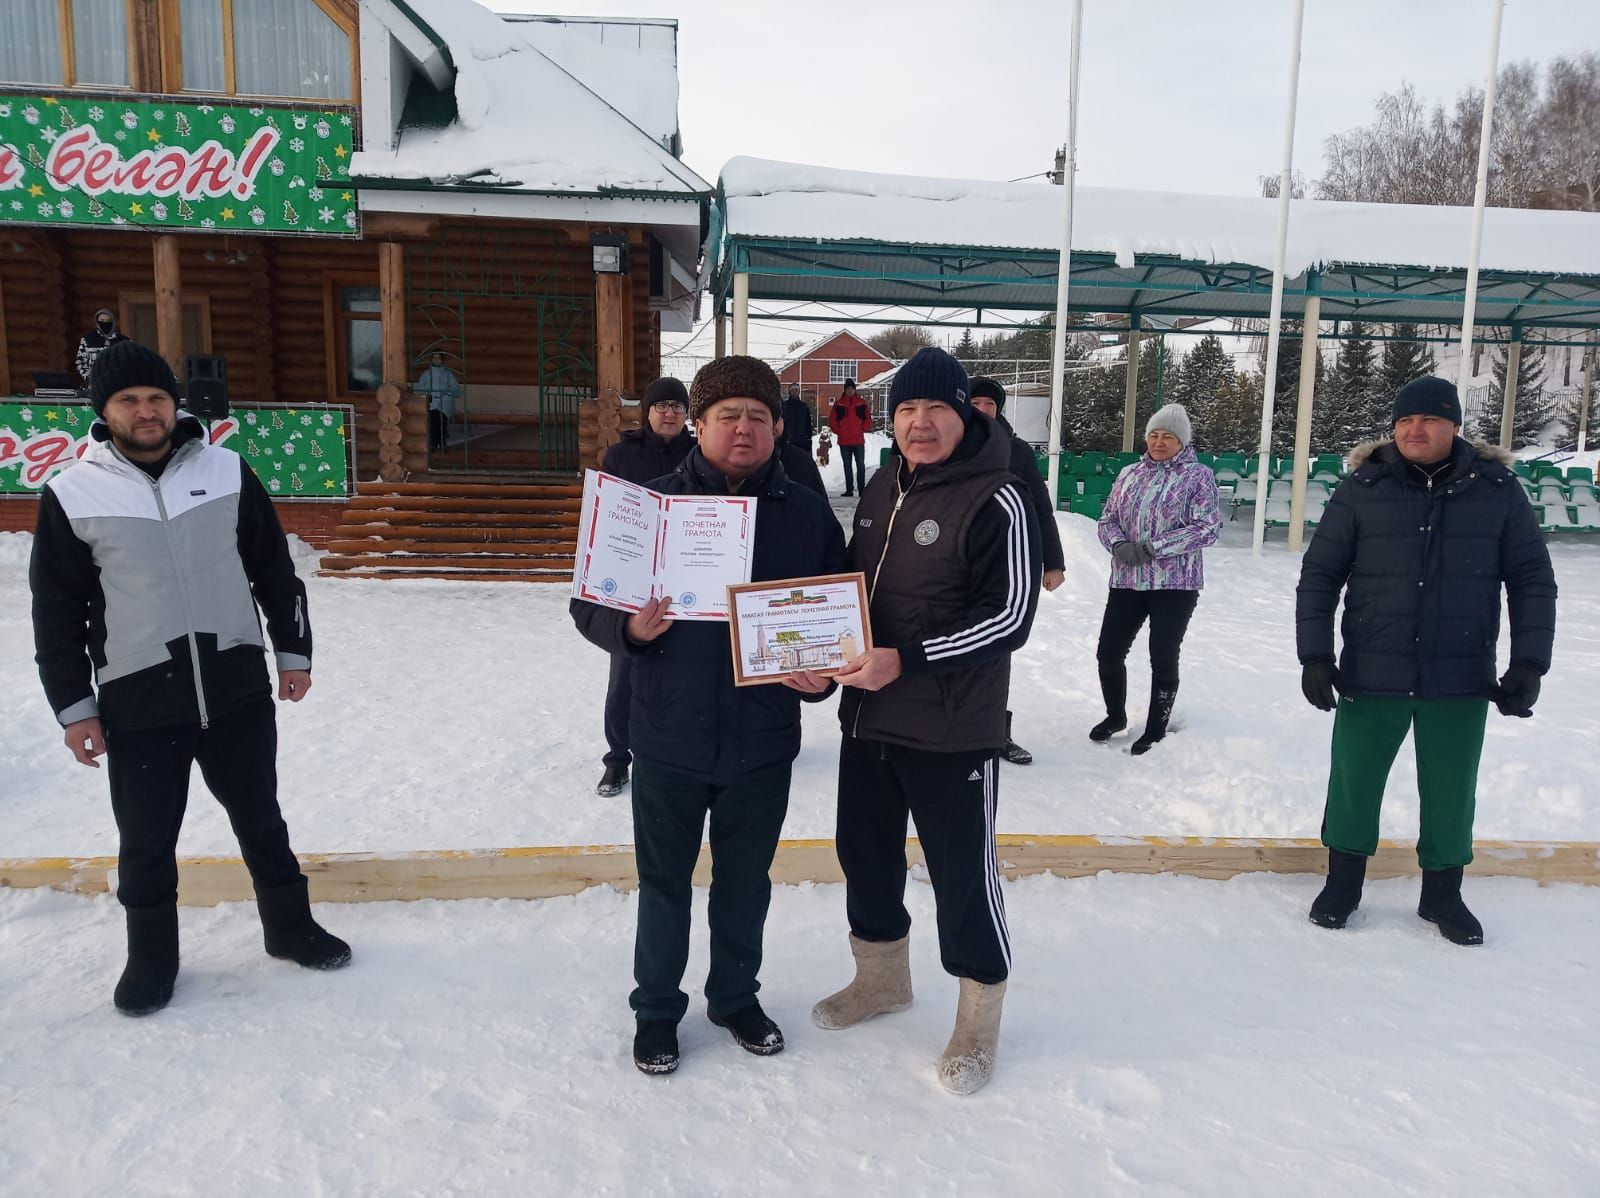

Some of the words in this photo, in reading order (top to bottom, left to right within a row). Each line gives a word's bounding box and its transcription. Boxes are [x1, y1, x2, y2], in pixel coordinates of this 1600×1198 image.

[617, 504, 643, 518] МАКТАУ
[608, 511, 649, 530] ГРАМОТАСЫ
[682, 520, 727, 528] ПОЧЕТНАЯ
